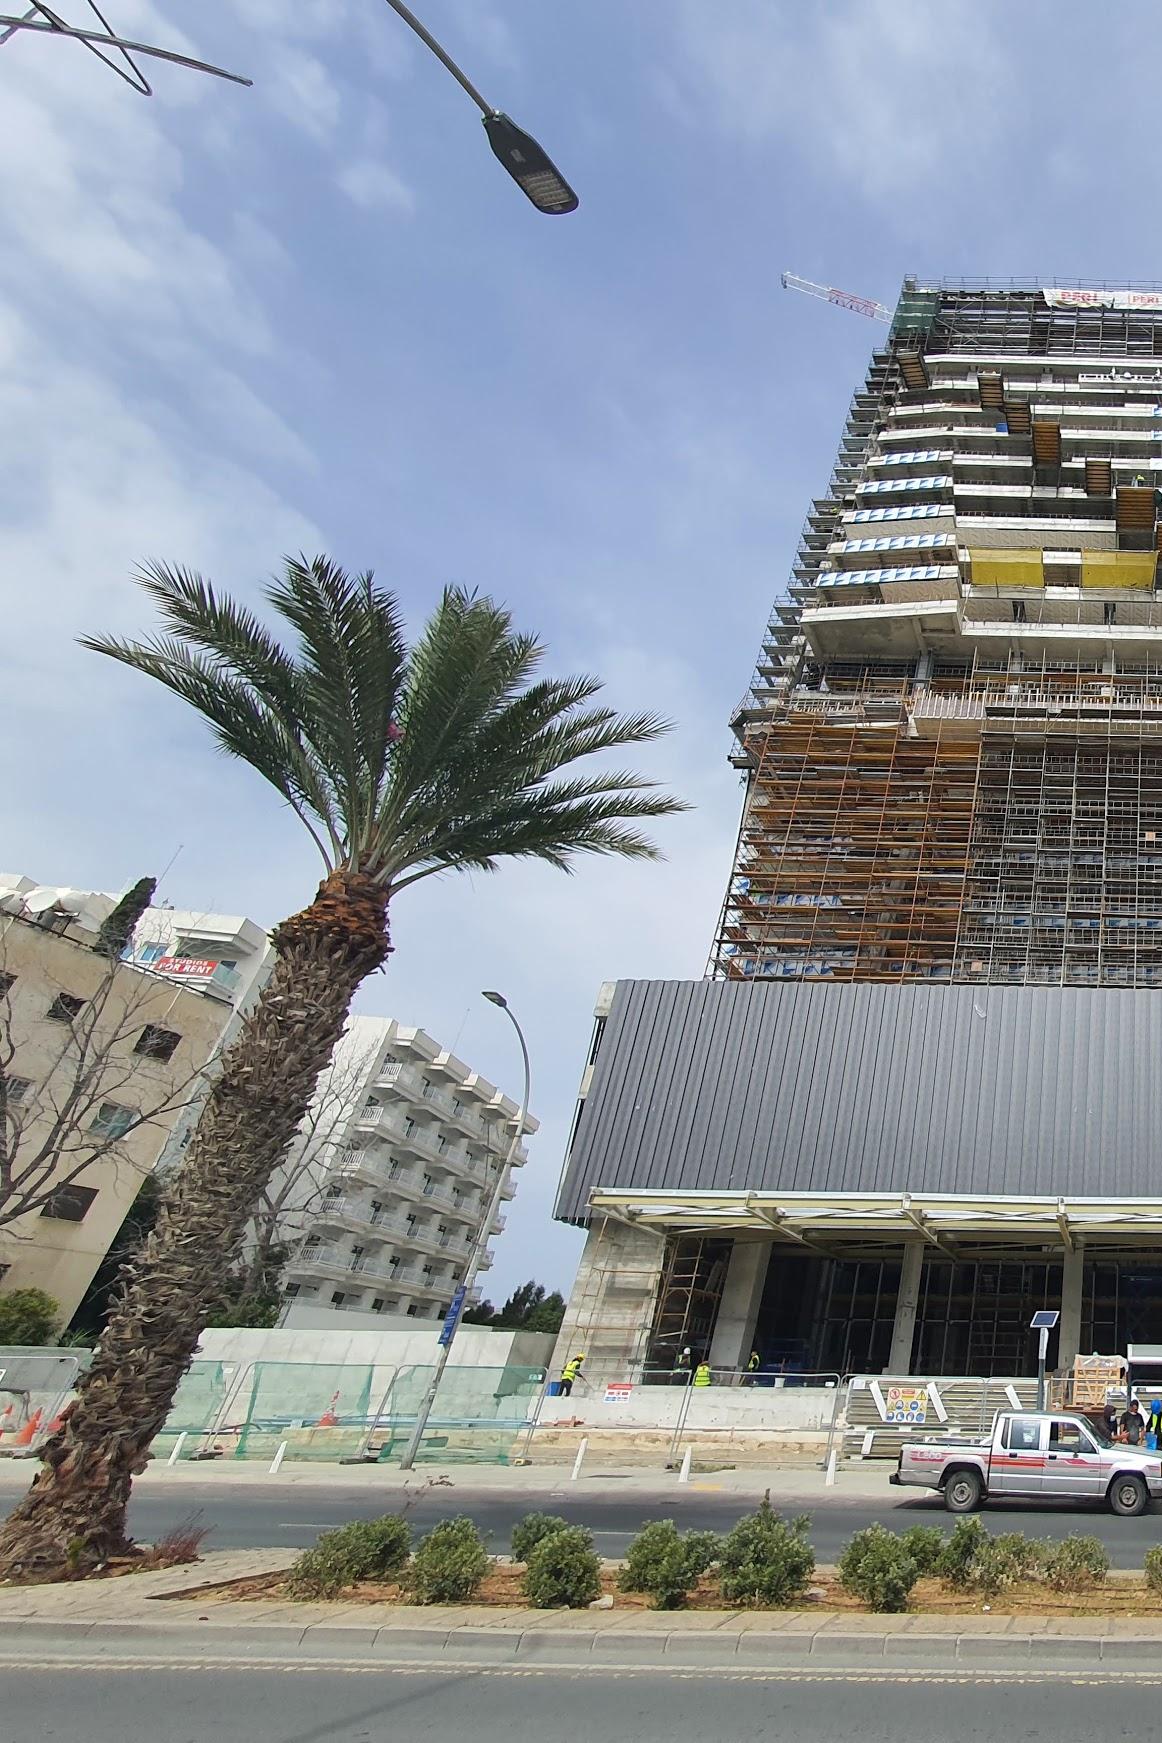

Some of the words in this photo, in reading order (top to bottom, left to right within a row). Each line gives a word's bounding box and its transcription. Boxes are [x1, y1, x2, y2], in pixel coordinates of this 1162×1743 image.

[1132, 295, 1159, 303] PERI
[168, 958, 209, 966] STUDIOS
[158, 962, 181, 971] FOR
[182, 965, 213, 974] RENT
